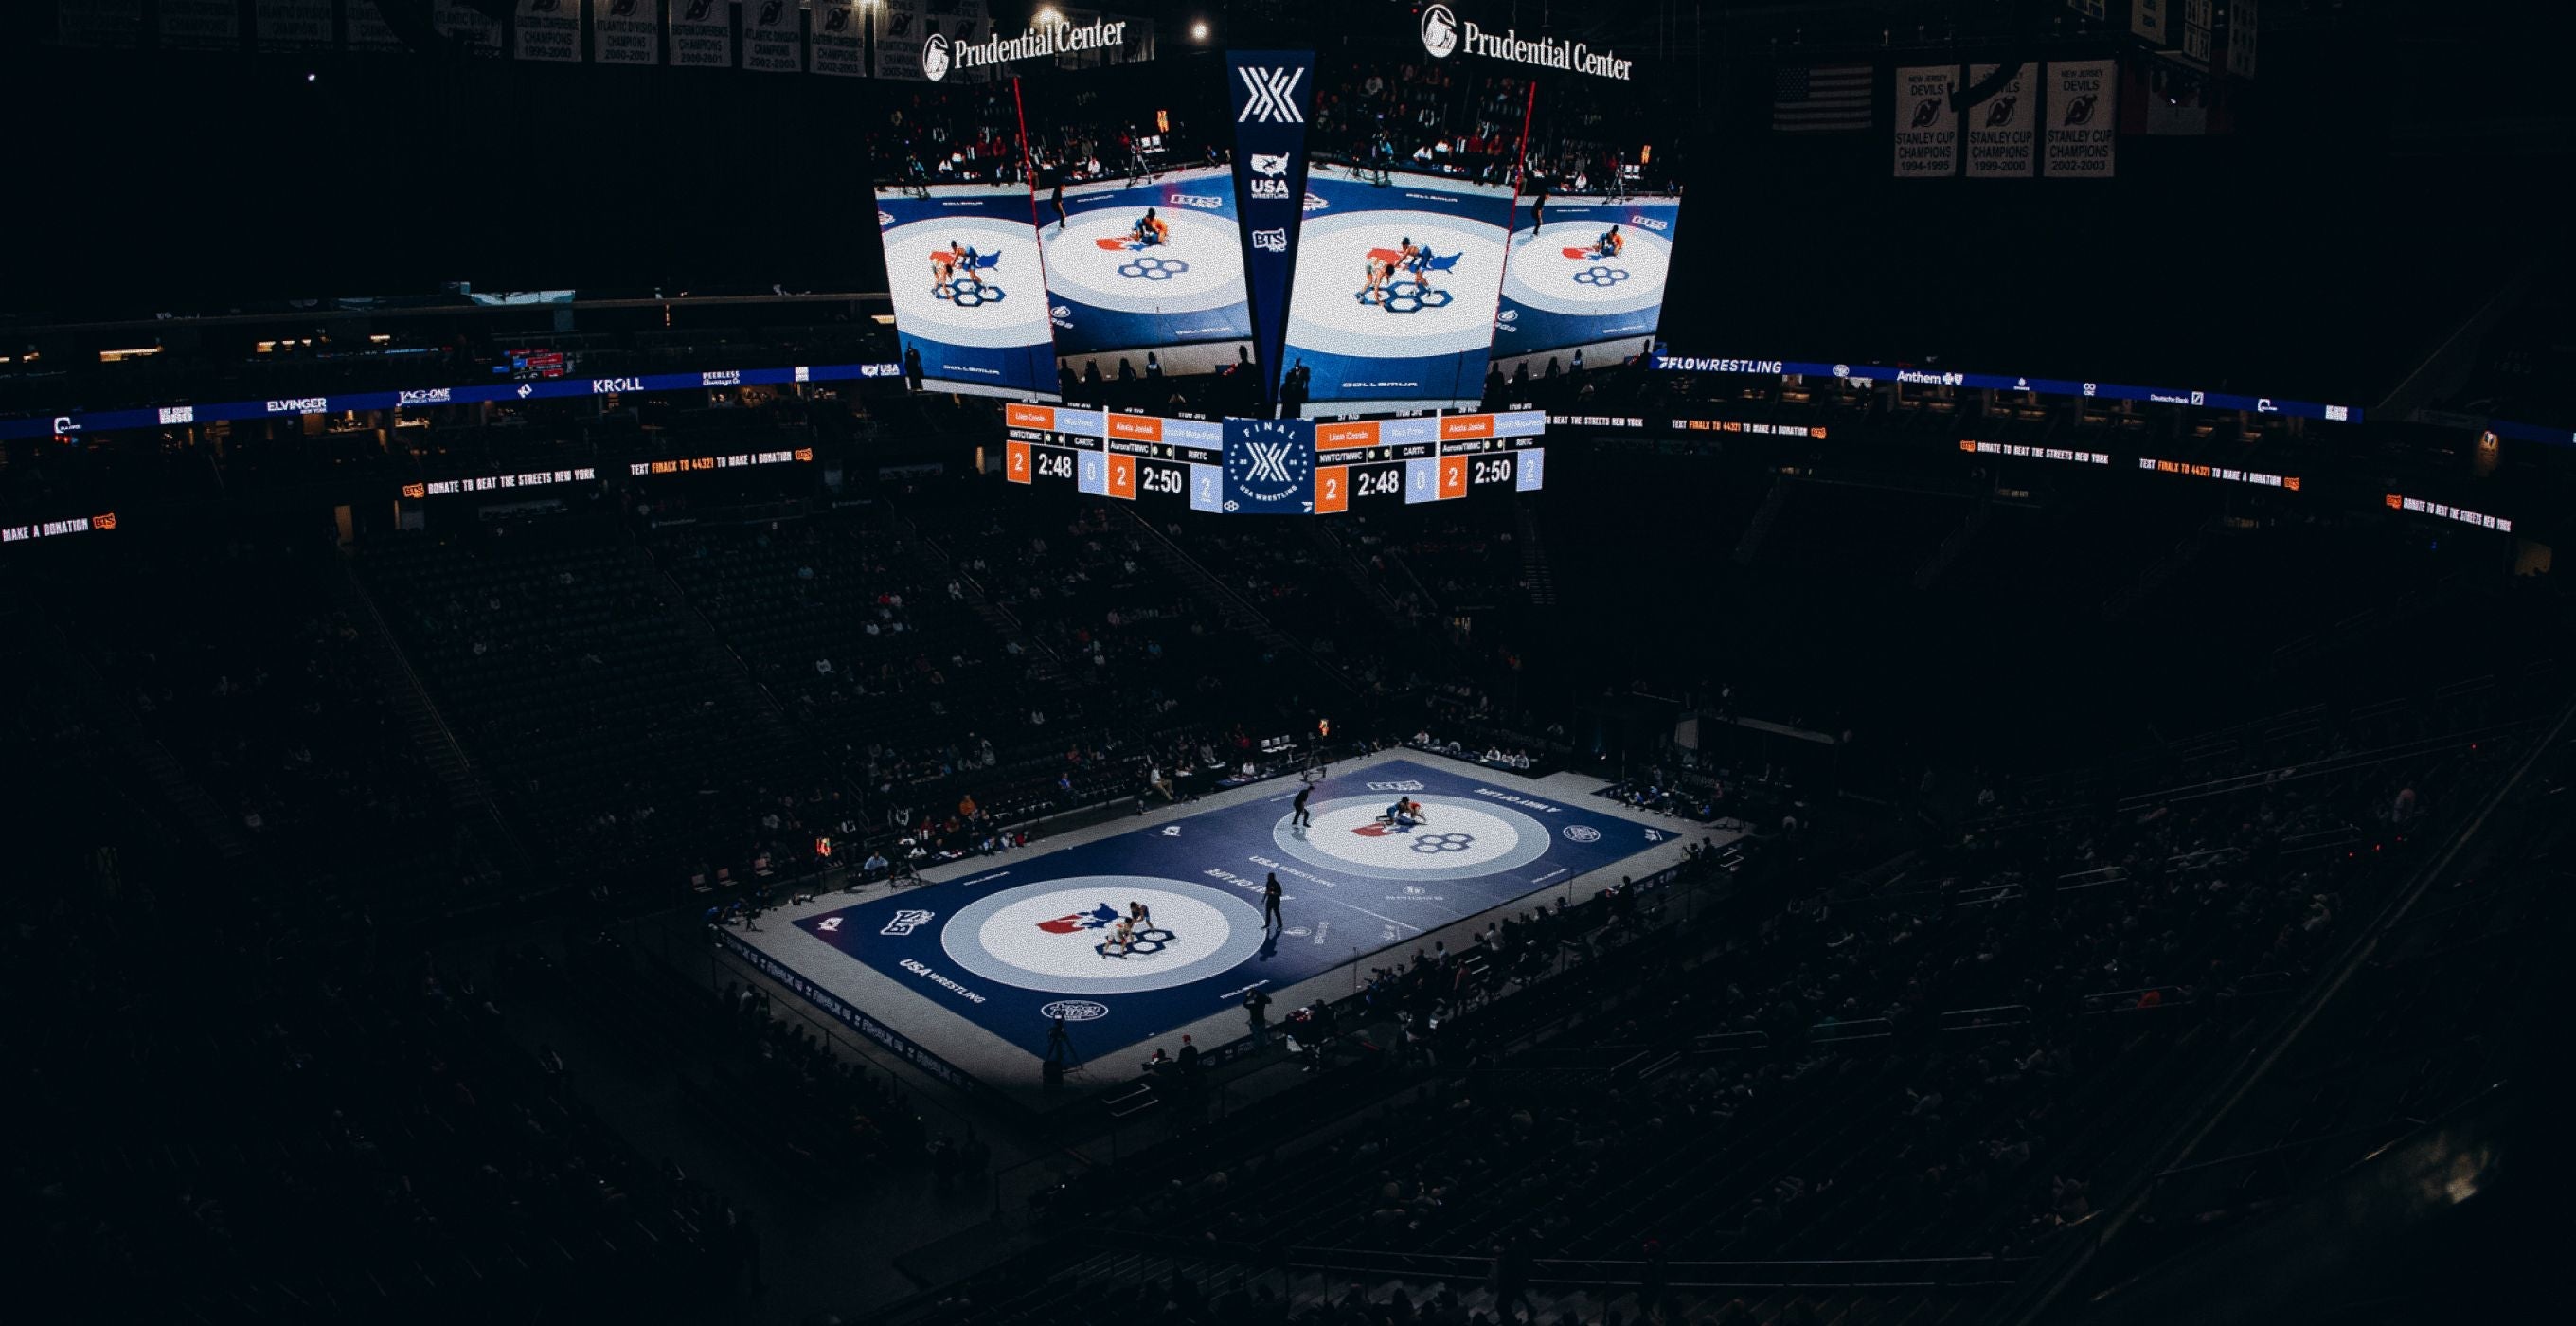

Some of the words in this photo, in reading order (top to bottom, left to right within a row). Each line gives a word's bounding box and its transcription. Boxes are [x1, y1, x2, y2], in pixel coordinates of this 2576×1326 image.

[525, 30, 572, 45] CHAMPIONS
[607, 36, 646, 47] CHAMPIONS
[954, 24, 1054, 69] Prudential
[1056, 16, 1126, 54] Center
[817, 49, 858, 62] CHAMPIONS
[1463, 21, 1572, 70] Prudential
[1574, 43, 1633, 81] Center
[1910, 84, 1944, 96] DEVILS
[2063, 80, 2100, 92] DEVILS
[1896, 133, 1935, 144] STANLEY
[1936, 131, 1955, 143] CUP
[1970, 132, 2011, 144] STANLEY
[2013, 131, 2032, 144] CUP
[2048, 131, 2090, 143] STANLEY
[2092, 129, 2113, 142] CUP
[1899, 146, 1951, 159] CHAMPIONS
[1971, 146, 2029, 159] CHAMPIONS
[2049, 145, 2108, 158] CHAMPIONS
[1901, 161, 1949, 170] 1994-1995
[1975, 161, 2026, 170] 1999-2000
[2052, 161, 2105, 170] 2002-2003
[1251, 179, 1288, 193] USA
[1253, 229, 1287, 248] BTS
[1668, 357, 1782, 374] FLOWRESTLING
[702, 370, 740, 379] PEERLESS
[1897, 370, 1942, 385] Anthem
[593, 377, 644, 394] KROLL
[266, 397, 327, 412] ELVINGER
[396, 388, 451, 407] JAG-ONE
[1672, 419, 1687, 429] TEXT
[1743, 422, 1751, 433] TO
[1771, 424, 1776, 435] A
[1403, 446, 1425, 456] CARTC
[2004, 444, 2012, 455] TO
[2091, 453, 2109, 465] YORK
[631, 463, 649, 475] TEXT
[651, 460, 678, 474] FINALX
[679, 459, 689, 472] TO
[691, 457, 714, 470] 44321
[716, 456, 726, 468] TO
[728, 454, 748, 467] MAKE
[750, 453, 757, 465] A
[759, 451, 792, 464] DONATION
[1014, 452, 1023, 472] 2
[1038, 453, 1072, 478] 2:48
[1526, 458, 1535, 481] 2
[2139, 457, 2156, 471] TEXT
[2212, 467, 2221, 479] TO
[2242, 471, 2247, 483] A
[1087, 461, 1096, 481] 0
[1117, 465, 1126, 486] 2
[1417, 469, 1425, 490] 0
[1448, 467, 1458, 487] 2
[1474, 459, 1511, 484] 2:50
[428, 480, 459, 494] DONATE
[462, 478, 473, 492] TO
[476, 476, 497, 491] BEAT
[500, 475, 515, 488] THE
[518, 472, 551, 486] STREETS
[555, 470, 571, 482] NEW
[574, 467, 595, 480] YORK
[1142, 466, 1182, 494] 2:50
[1201, 476, 1211, 498] 2
[1357, 470, 1399, 496] 2:48
[1255, 485, 1297, 502] WRESTLING
[1326, 478, 1337, 500] 2
[93, 513, 116, 529] BTS
[2, 526, 29, 542] MAKE
[33, 525, 40, 538] A
[43, 518, 88, 536] DONATION
[1249, 855, 1279, 868] USA
[899, 958, 933, 977] USA
[929, 972, 986, 1004] WRESTLING
